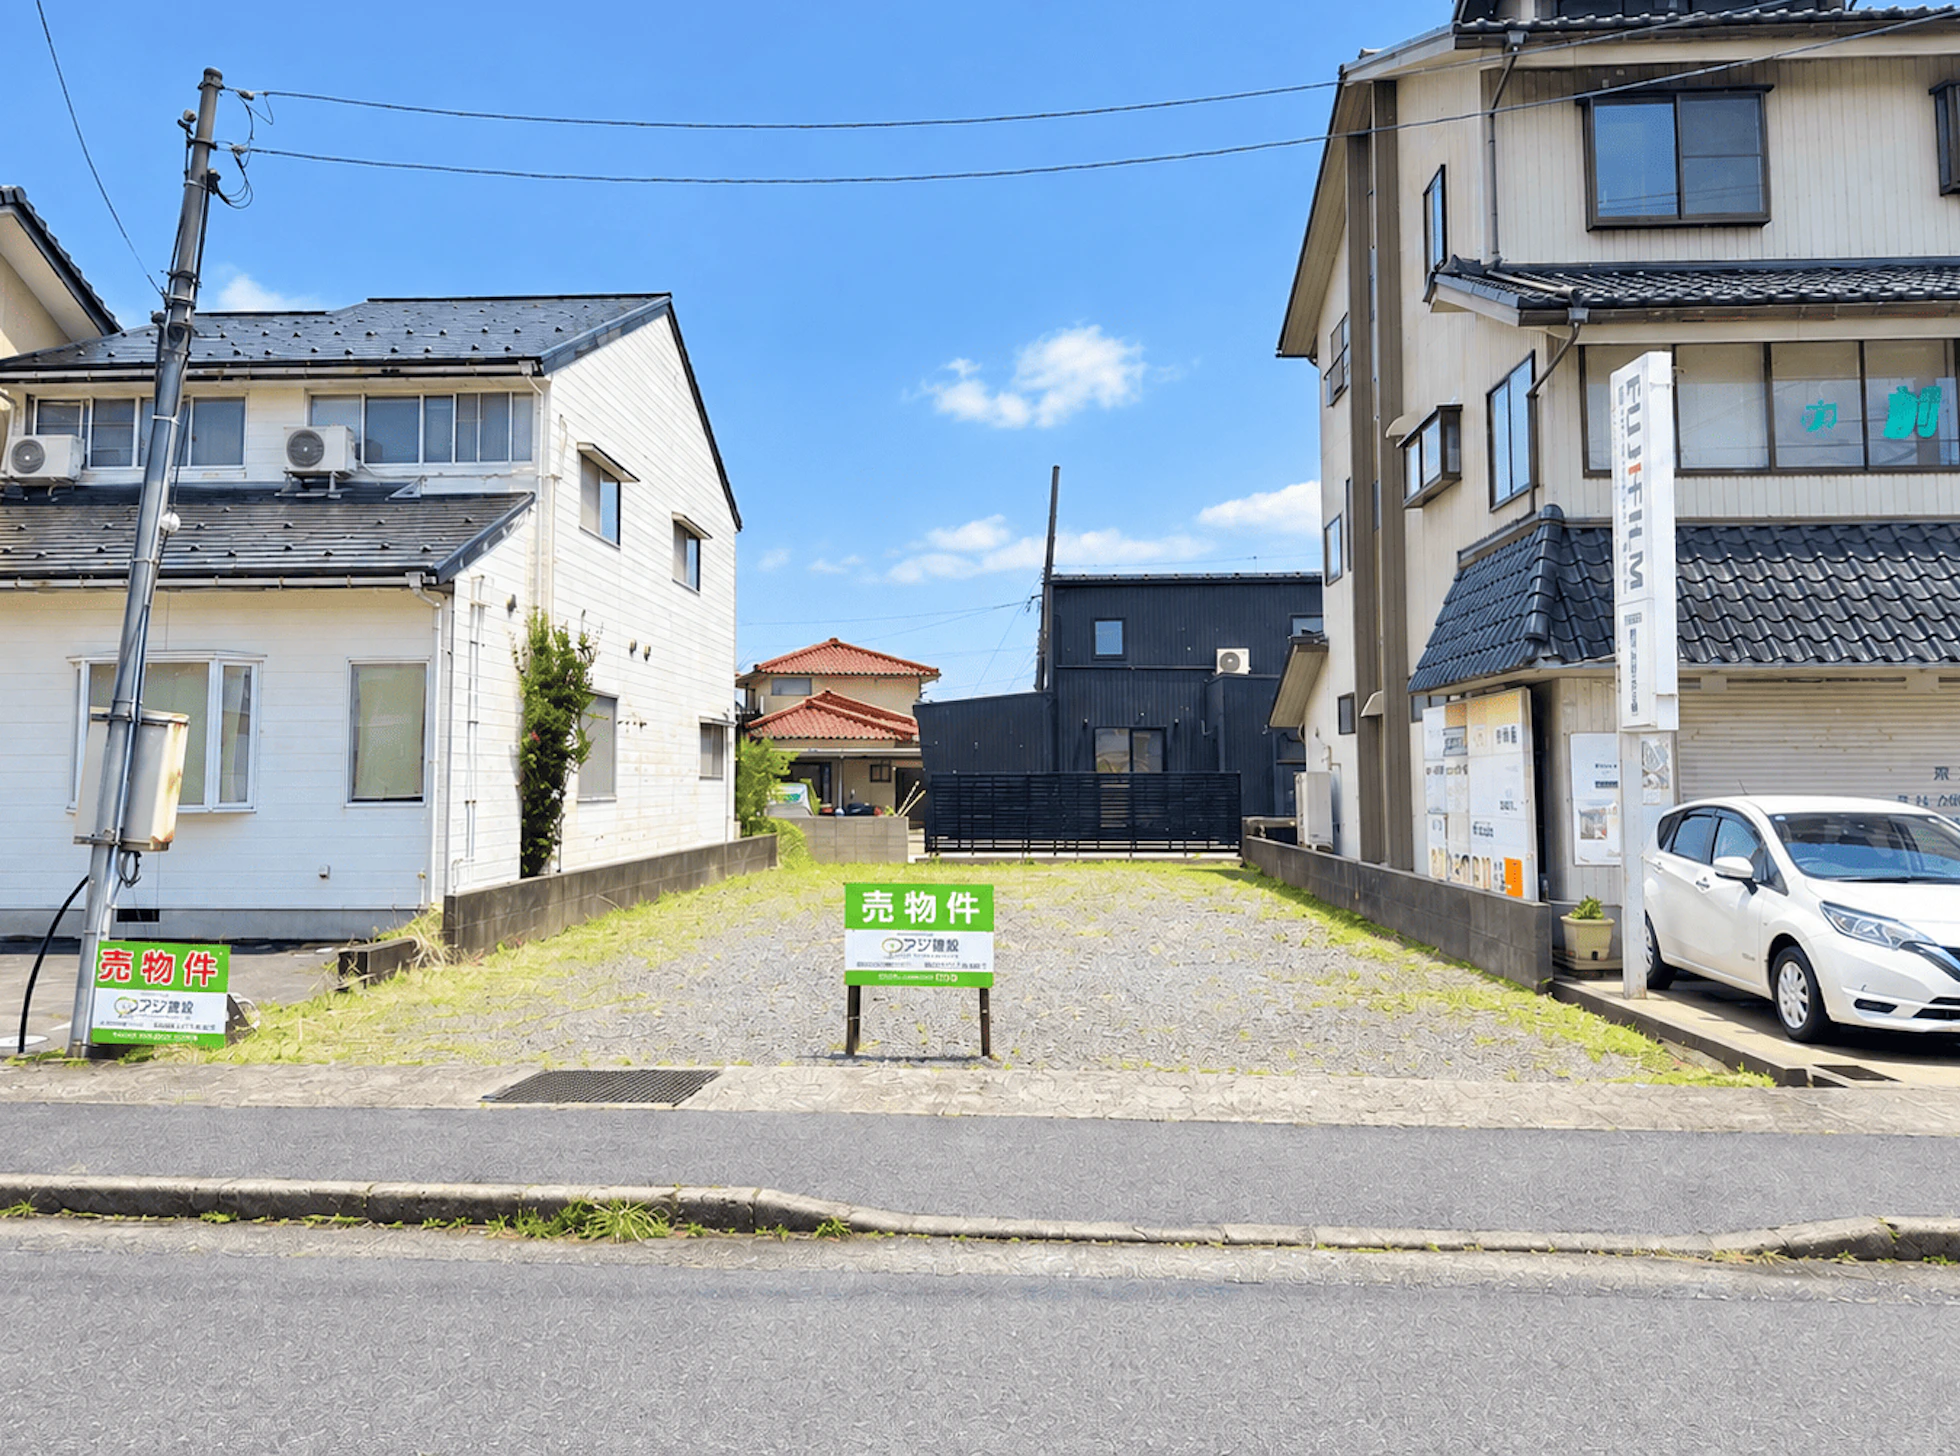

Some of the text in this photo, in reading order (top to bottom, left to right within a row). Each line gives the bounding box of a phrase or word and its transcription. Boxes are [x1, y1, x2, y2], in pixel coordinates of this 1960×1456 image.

[1626, 374, 1643, 590] FUJIFILM
[862, 890, 980, 925] 売物件
[98, 948, 219, 988] 売物件
